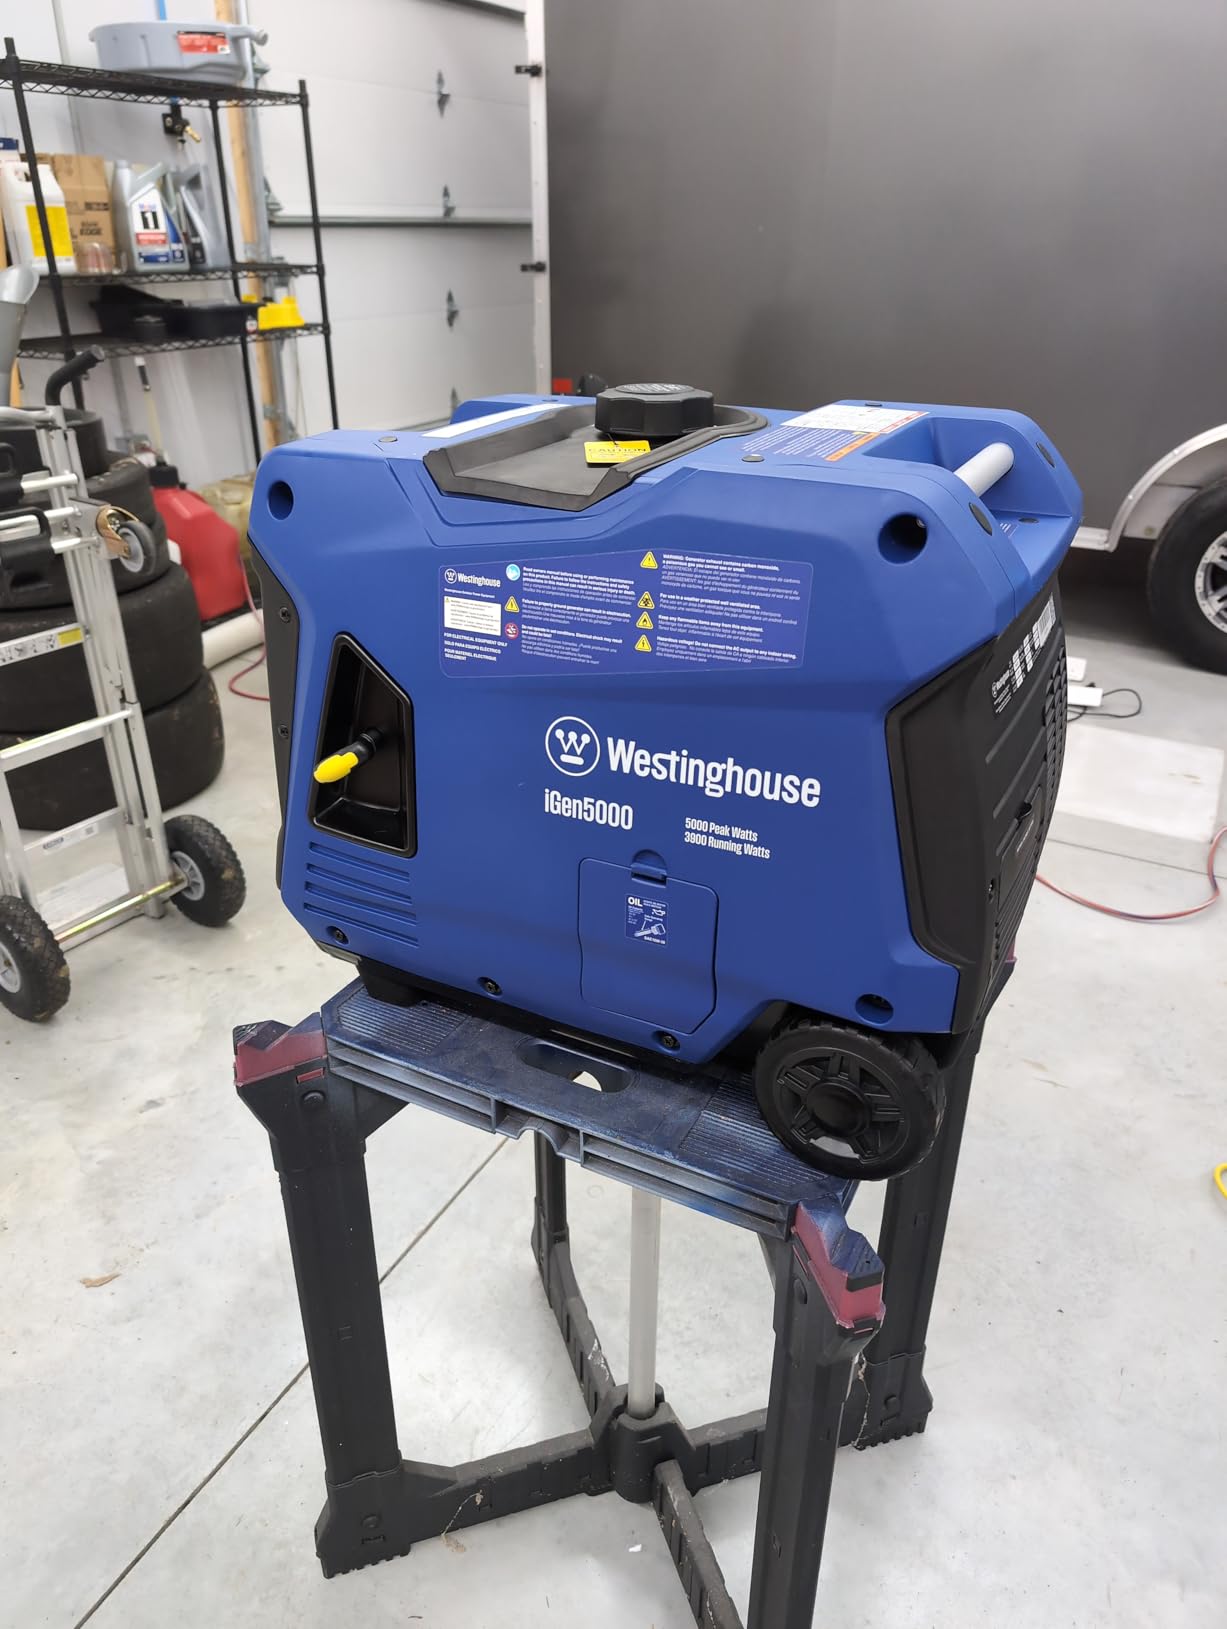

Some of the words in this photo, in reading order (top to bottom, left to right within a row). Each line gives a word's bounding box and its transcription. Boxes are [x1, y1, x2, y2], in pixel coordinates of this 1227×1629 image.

[457, 572, 501, 588] Westinghouse
[606, 736, 821, 808] Westinghouse
[544, 788, 634, 830] iGen5000
[684, 817, 709, 833] 5000
[709, 821, 730, 837] Peak
[731, 826, 758, 842] Watts
[684, 831, 707, 846] 3900
[708, 836, 743, 856] Running
[743, 843, 771, 859] Watts
[628, 896, 643, 907] OIL
